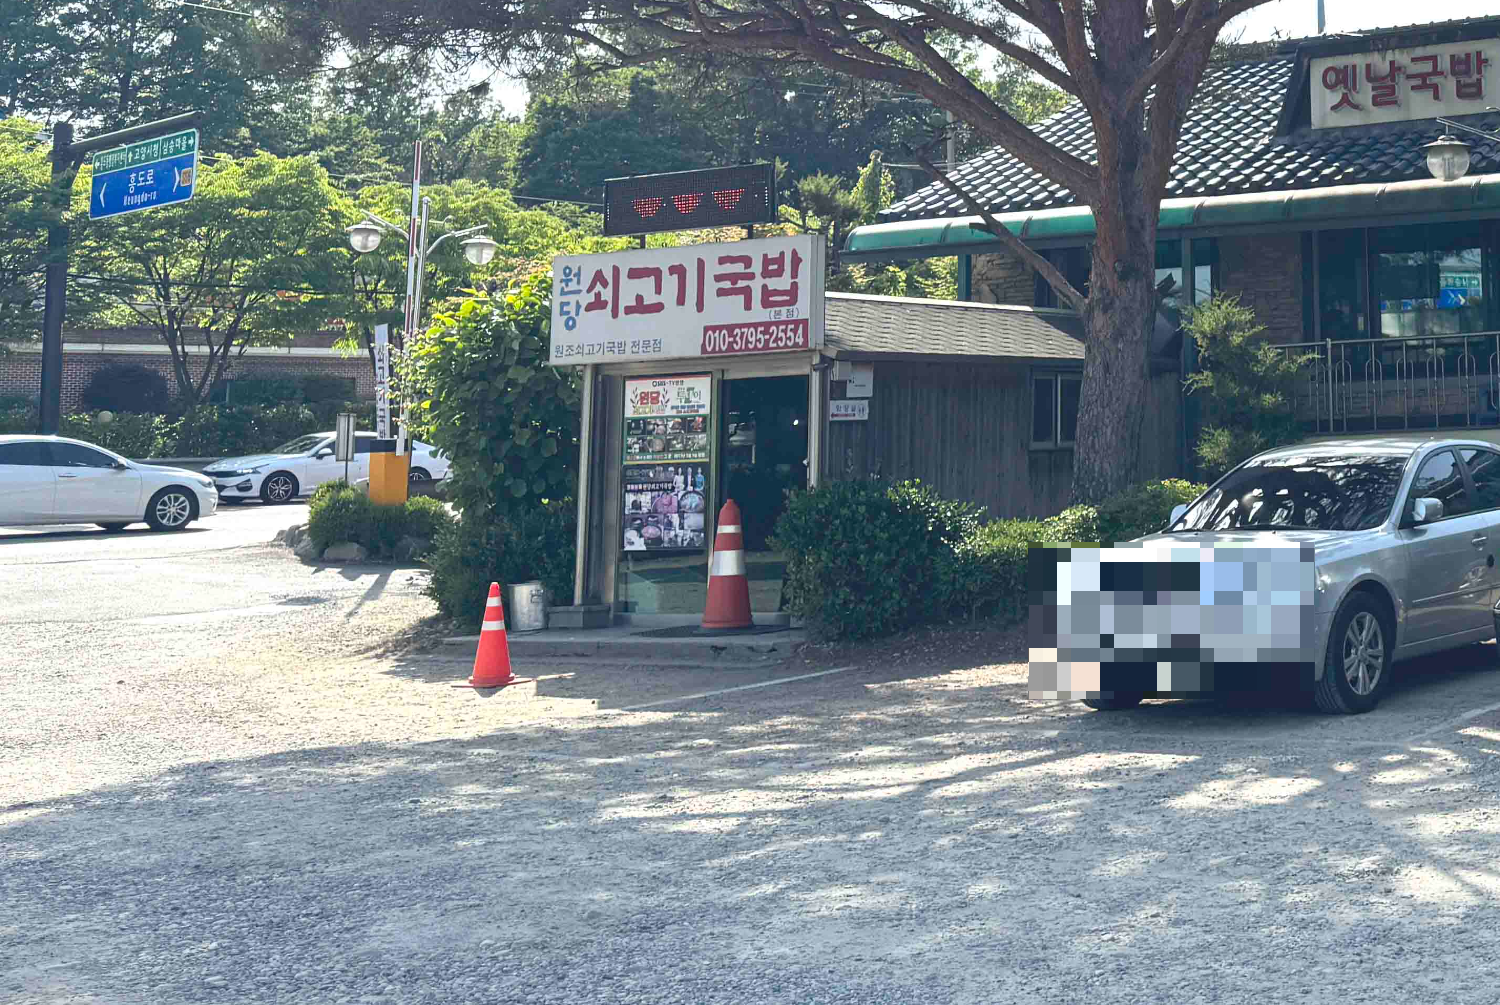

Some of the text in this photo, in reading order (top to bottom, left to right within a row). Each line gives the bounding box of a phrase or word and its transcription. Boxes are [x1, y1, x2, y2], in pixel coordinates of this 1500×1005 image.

[1322, 51, 1489, 111] 옛날국밥
[134, 143, 159, 160] 고양시청
[163, 136, 187, 154] 삼송마을
[128, 169, 154, 194] 흥도로
[584, 248, 803, 320] 쇠고기국밥
[559, 265, 583, 331] 원당
[554, 338, 662, 358] 원조쇠고기국밥 전문점
[705, 324, 805, 352] 010-3795-2554
